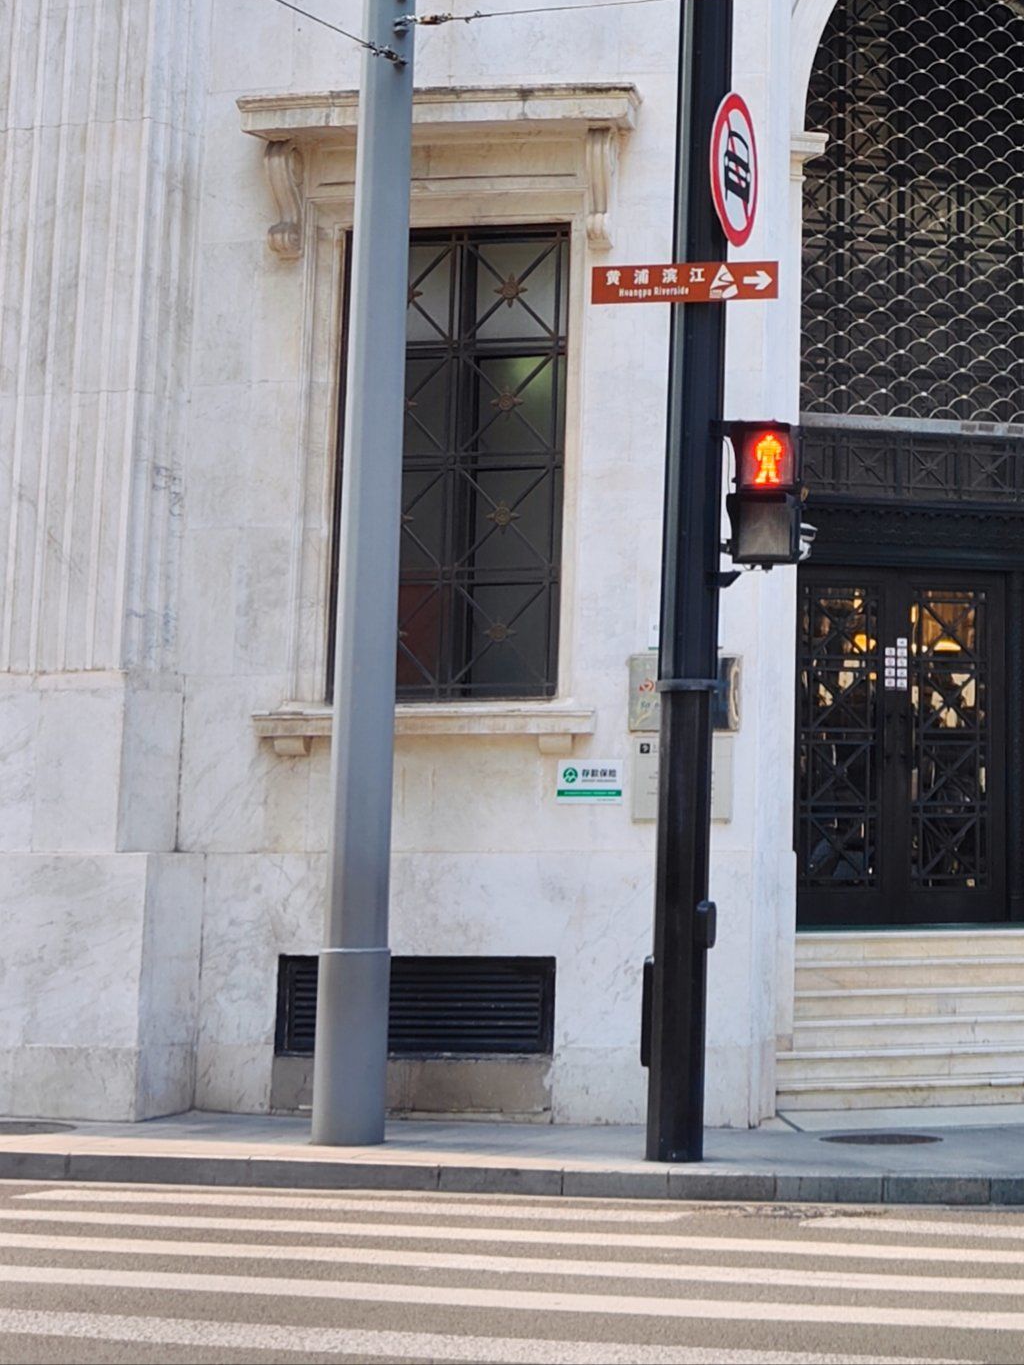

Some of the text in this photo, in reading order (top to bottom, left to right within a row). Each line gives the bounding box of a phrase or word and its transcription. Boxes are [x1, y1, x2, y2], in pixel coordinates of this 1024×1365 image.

[606, 267, 705, 285] 黄浦滨江
[618, 286, 689, 299] Huangpu Riverside
